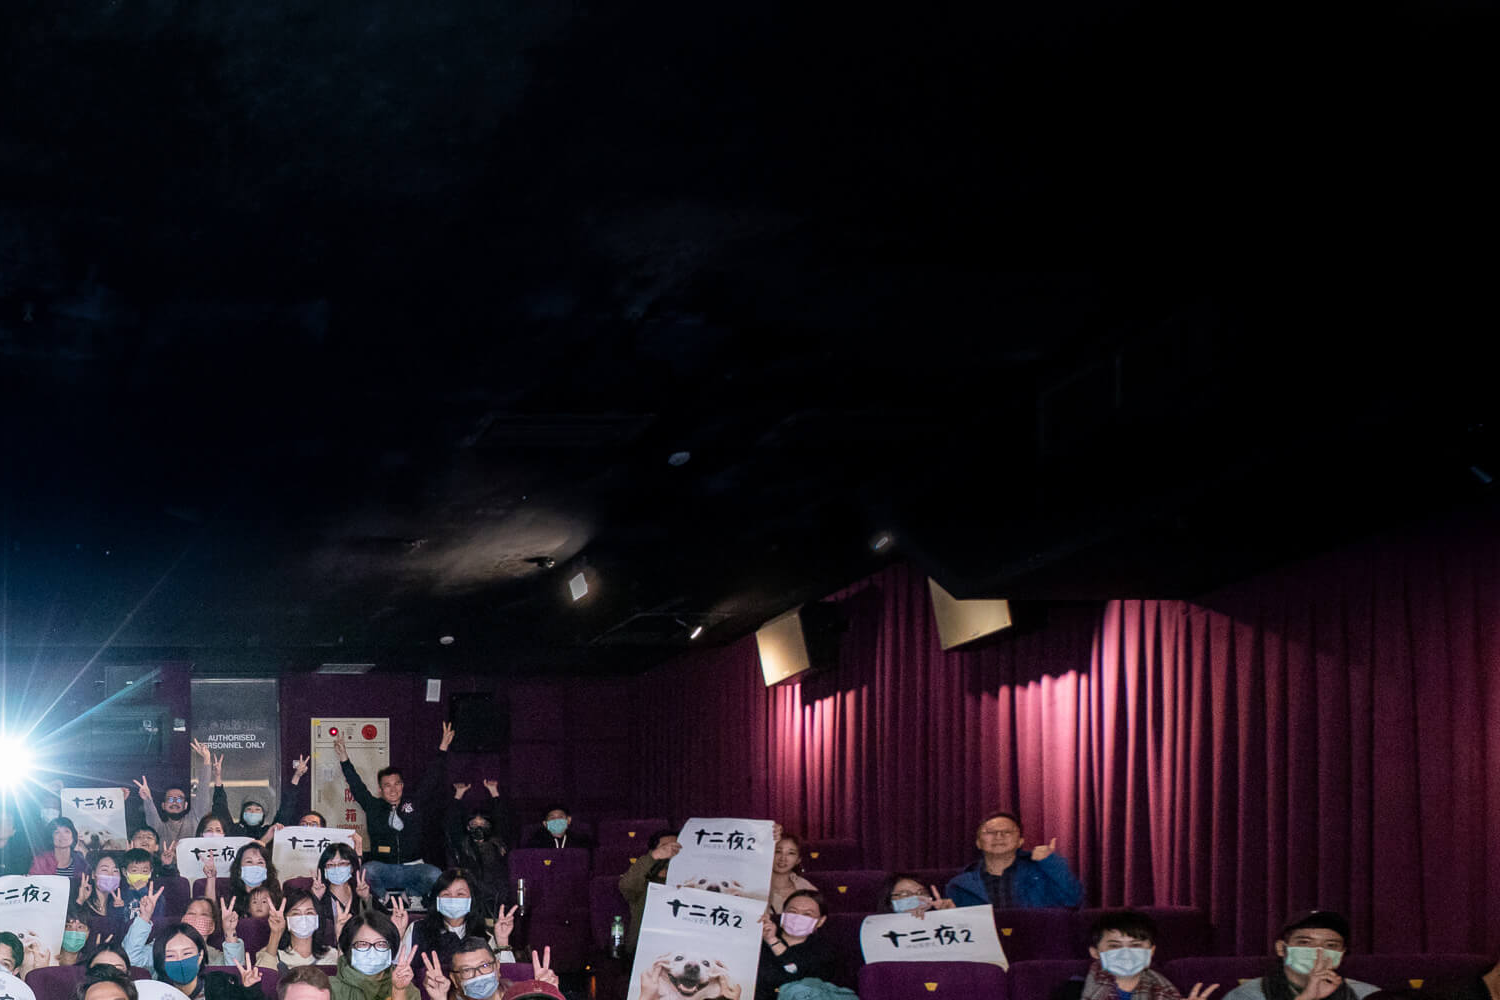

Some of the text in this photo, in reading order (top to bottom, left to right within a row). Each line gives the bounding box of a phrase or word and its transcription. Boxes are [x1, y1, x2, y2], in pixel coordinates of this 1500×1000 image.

[72, 796, 114, 811] 十二夜2
[287, 836, 331, 853] 十二夜
[695, 828, 757, 851] 十二夜2
[190, 845, 235, 863] 十二夜
[667, 899, 743, 929] 十二夜2
[881, 924, 975, 948] 十二夜2
